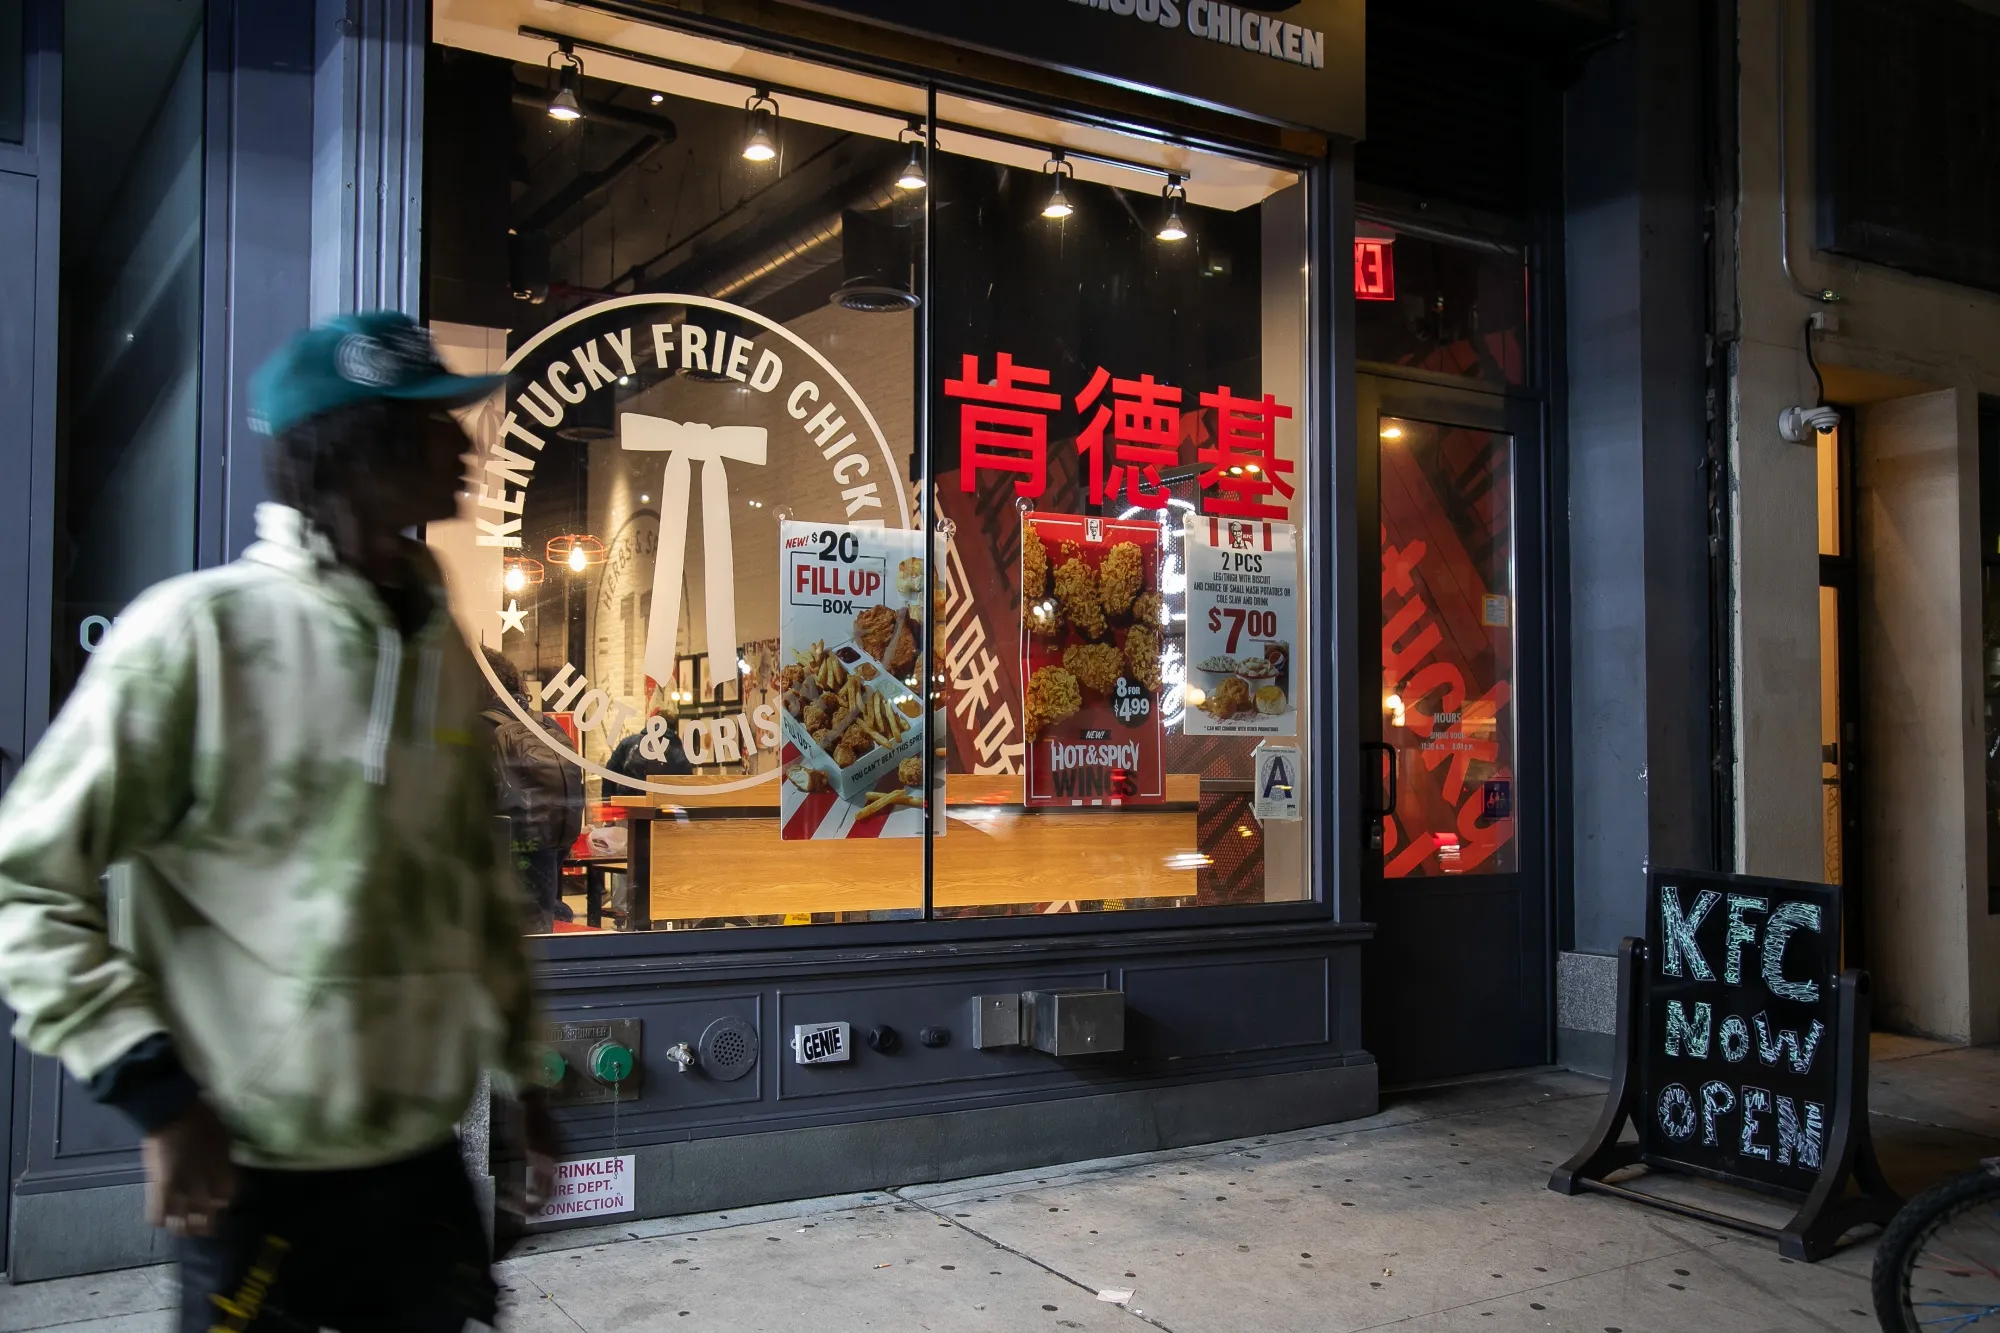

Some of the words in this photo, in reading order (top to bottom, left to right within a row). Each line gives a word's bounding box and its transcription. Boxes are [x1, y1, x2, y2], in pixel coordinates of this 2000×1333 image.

[1188, 0, 1325, 70] CHICKEN
[476, 328, 637, 548] KENTUCKY
[651, 323, 783, 393] FRIED
[787, 381, 884, 525] CHICK
[944, 351, 1296, 521] 肯德基
[785, 535, 809, 549] NEW!
[811, 530, 859, 563] $20
[1221, 551, 1230, 571] 2
[1234, 552, 1263, 573] PCS
[603, 539, 632, 611] HERBS
[796, 564, 846, 596] FILL
[848, 569, 881, 597] UP
[1193, 581, 1204, 591] AND
[1204, 582, 1222, 593] CHOICE
[1222, 583, 1229, 593] OF
[1229, 584, 1245, 594] SMALL
[1245, 585, 1260, 595] MASH
[1260, 586, 1283, 597] POTATOES
[1284, 588, 1291, 597] OR
[1239, 574, 1251, 584] WITH
[1252, 575, 1271, 585] BISCUIT
[822, 599, 853, 614] BOX
[1216, 594, 1228, 604] COLE
[1228, 594, 1242, 605] SLAW
[1242, 596, 1253, 606] AND
[1253, 597, 1269, 607] DRINK
[1116, 677, 1127, 697] 8
[1128, 686, 1141, 695] FOR
[540, 662, 638, 748] HOT
[640, 715, 670, 763] &
[683, 695, 781, 765] CRIS
[1433, 712, 1462, 724] HOURS
[1085, 730, 1106, 739] NEW!
[851, 770, 864, 783] YOU
[863, 760, 881, 775] CAN'T
[881, 749, 896, 764] BEAT
[896, 741, 909, 754] THIS
[909, 732, 923, 747] SPRE
[1263, 756, 1293, 798] A
[1661, 886, 1822, 1003] KFC
[803, 1027, 842, 1060] GENIE
[1665, 1000, 1825, 1075] NOW
[1657, 1080, 1825, 1173] OPEN
[552, 1160, 624, 1179] RINKLER
[554, 1183, 574, 1197] IRE
[577, 1180, 613, 1194] DEPT.
[538, 1196, 624, 1217] CONNECTION
